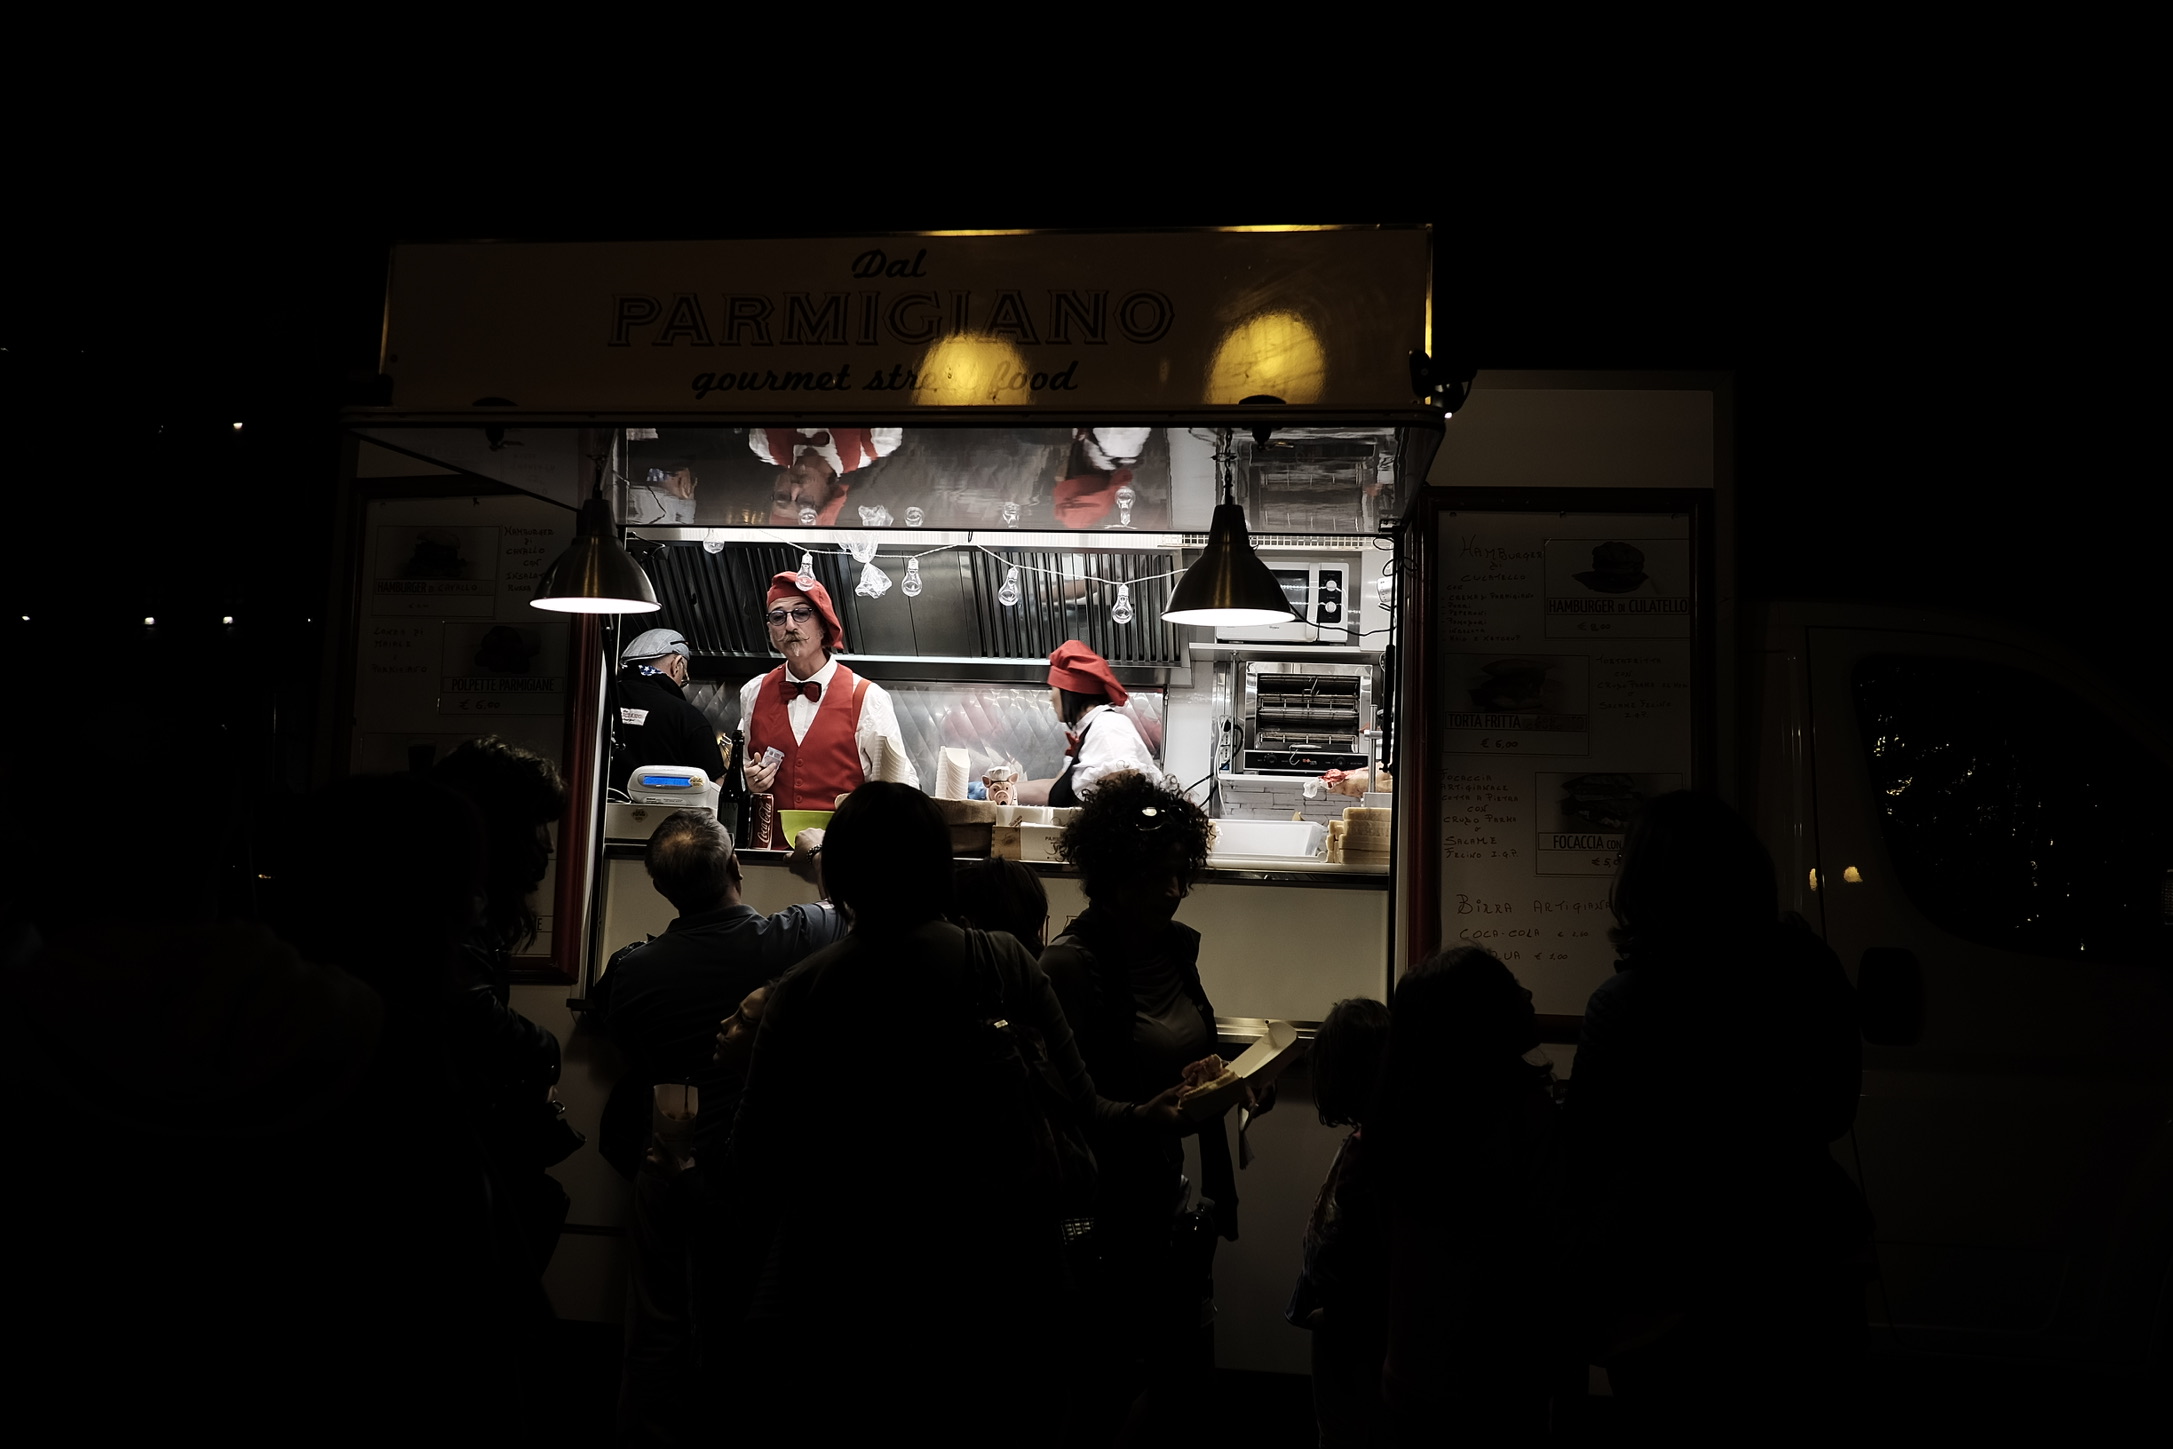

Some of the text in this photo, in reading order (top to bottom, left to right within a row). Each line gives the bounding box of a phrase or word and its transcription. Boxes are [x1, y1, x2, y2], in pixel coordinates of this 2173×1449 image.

[851, 249, 928, 279] Dal
[607, 288, 1176, 347] PARMIGIANO
[692, 362, 851, 400] gourmet
[377, 581, 427, 594] HAMBURGER
[1548, 599, 1615, 613] HAMBURGER
[1628, 599, 1688, 613] CULATELLO
[451, 678, 555, 692] POLPETTE PARMIGIANE
[1447, 713, 1483, 729] TORTA
[1484, 714, 1522, 729] FRITTA
[1552, 834, 1605, 850] FOCACCIA
